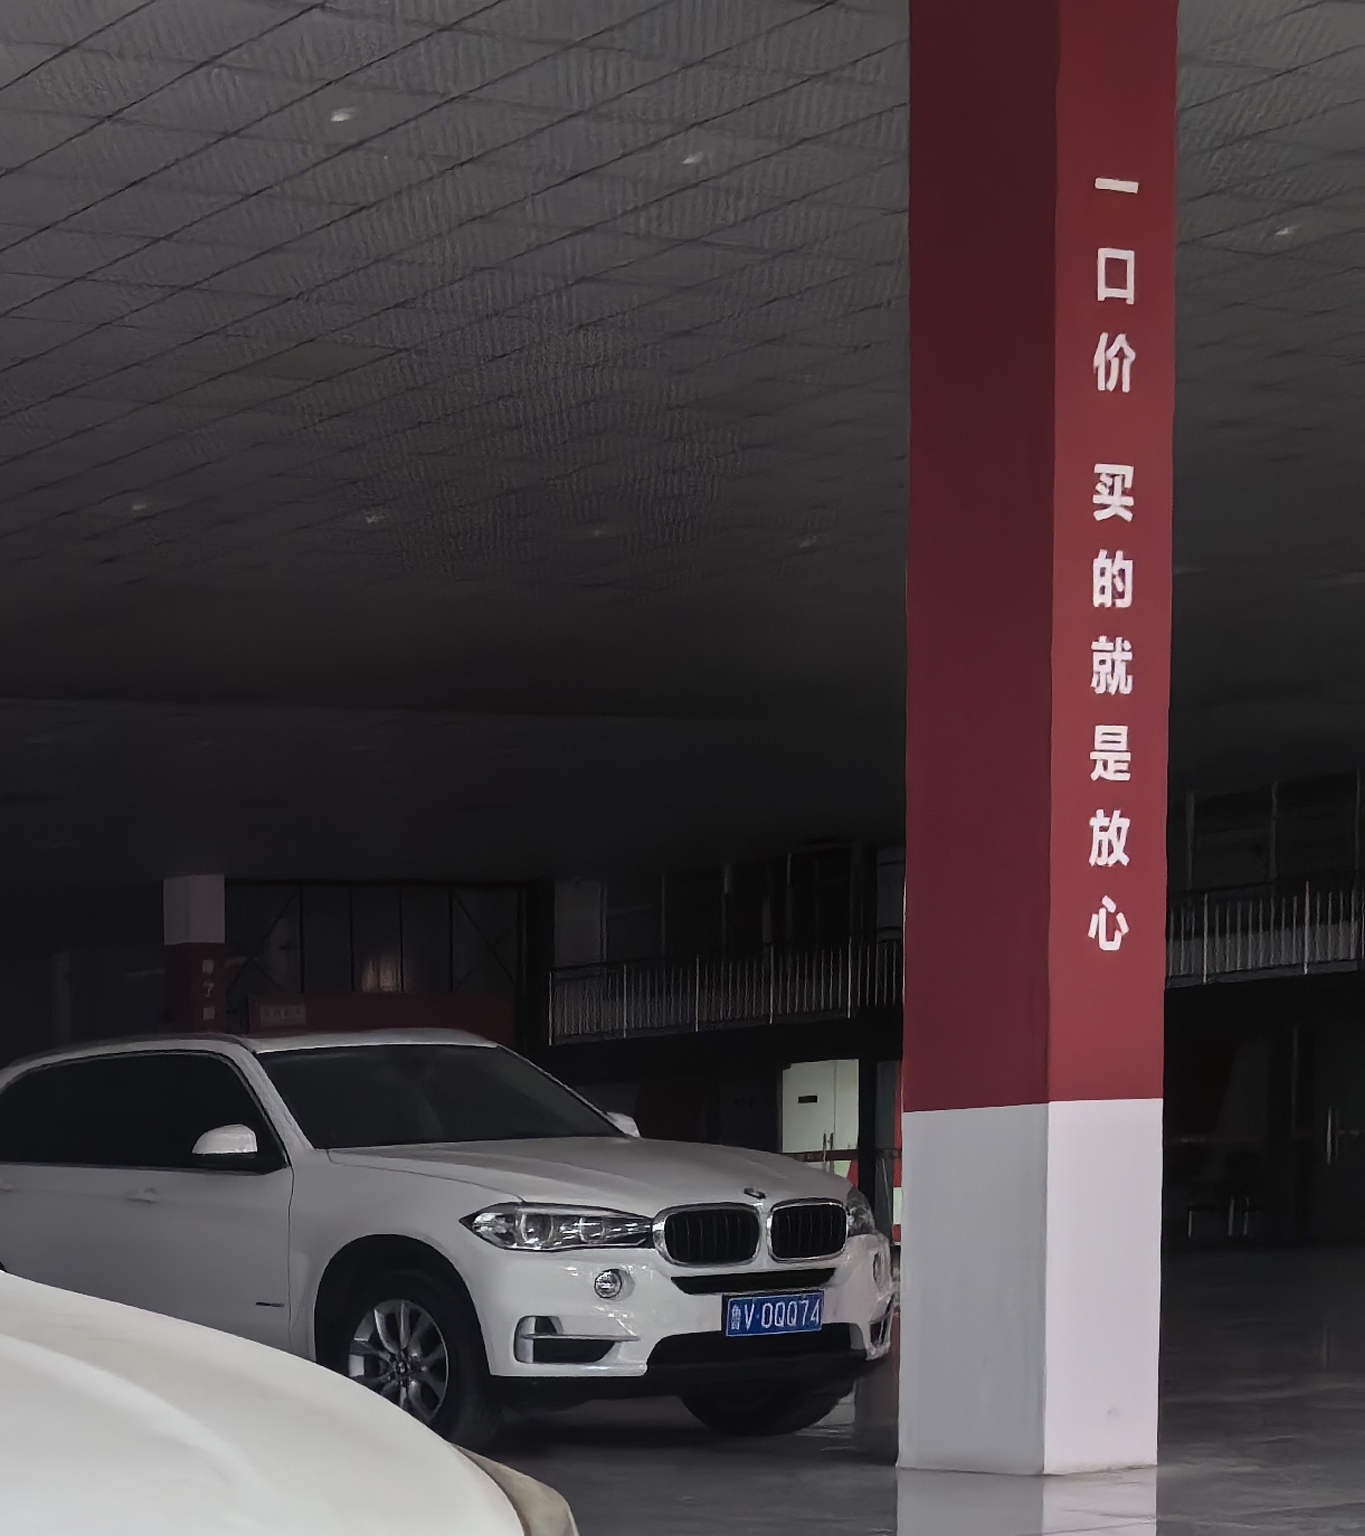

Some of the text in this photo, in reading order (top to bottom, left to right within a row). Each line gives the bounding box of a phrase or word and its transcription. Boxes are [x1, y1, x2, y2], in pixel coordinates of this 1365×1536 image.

[1088, 177, 1139, 951] 一口价 买的就是放心
